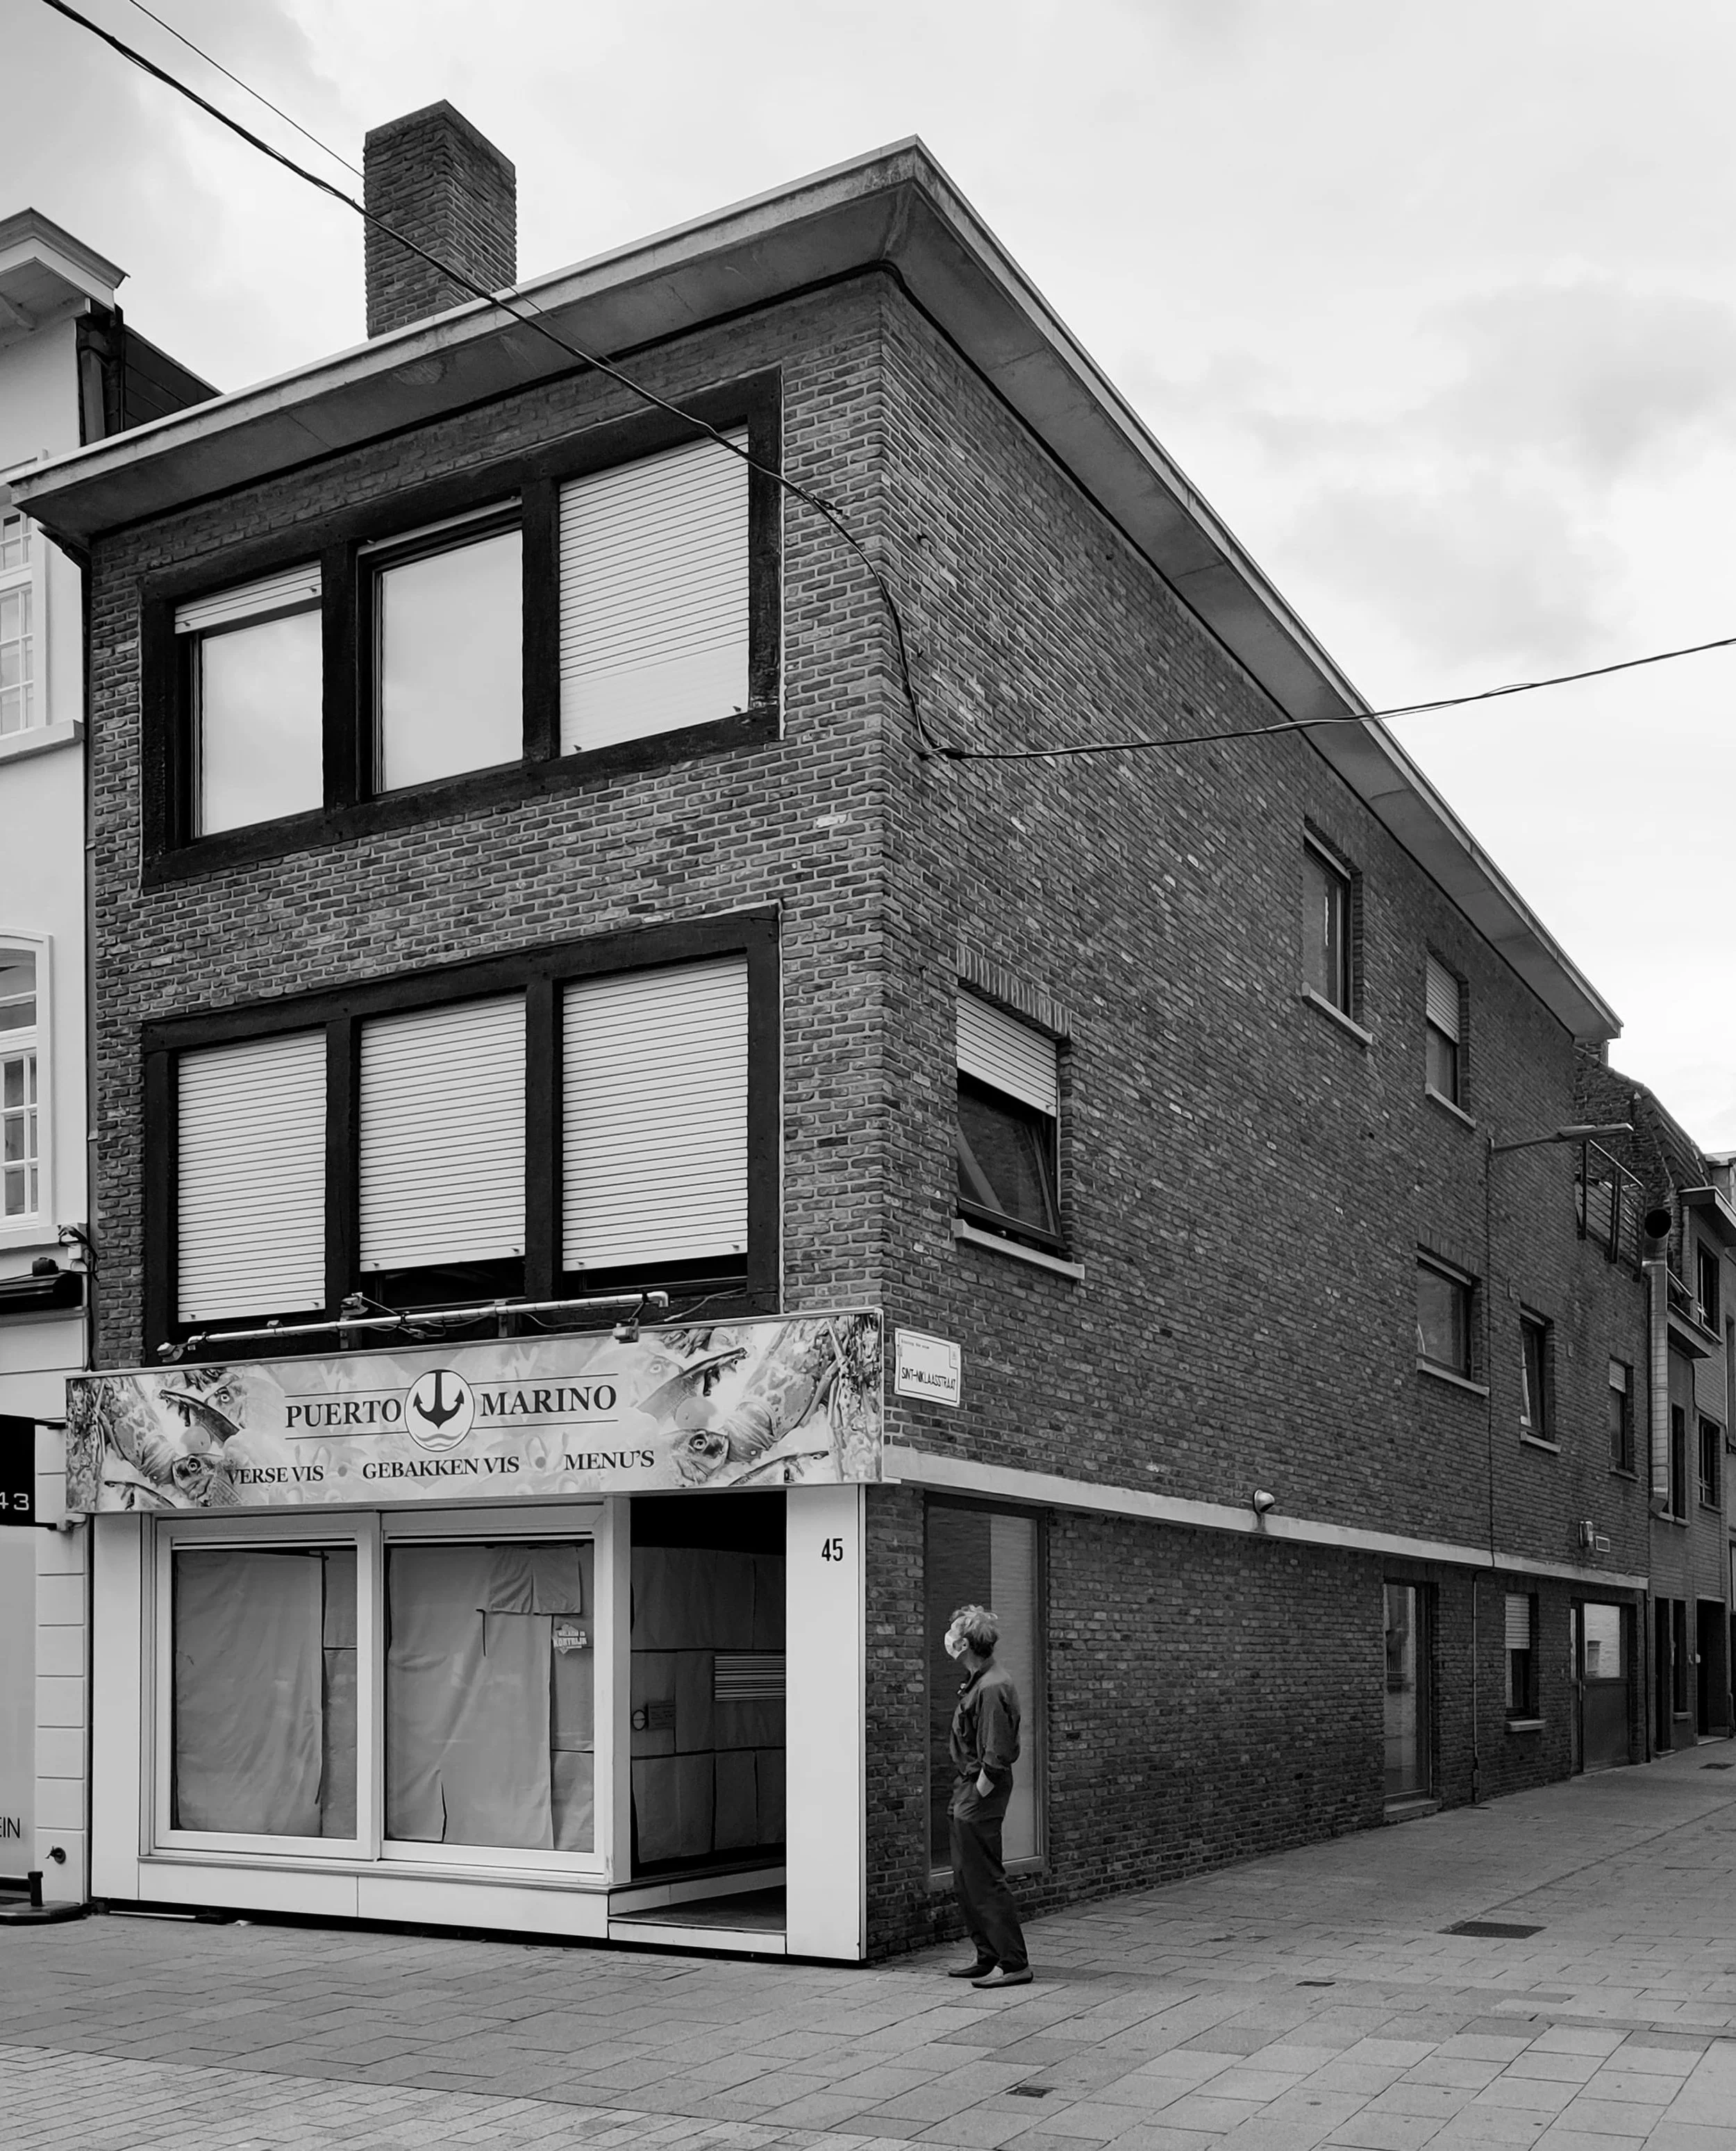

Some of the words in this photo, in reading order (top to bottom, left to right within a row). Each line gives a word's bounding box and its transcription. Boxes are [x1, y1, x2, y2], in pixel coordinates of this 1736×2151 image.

[285, 1398, 402, 1428] PUERTO
[480, 1385, 617, 1416] MARINO
[362, 1458, 479, 1479] GEBAKKEN
[484, 1456, 519, 1474] VIS
[565, 1450, 655, 1471] MENU'S
[227, 1466, 288, 1484] VERSE
[291, 1465, 324, 1482] VIS
[821, 1538, 843, 1562] 45
[0, 1816, 20, 1839] IN
